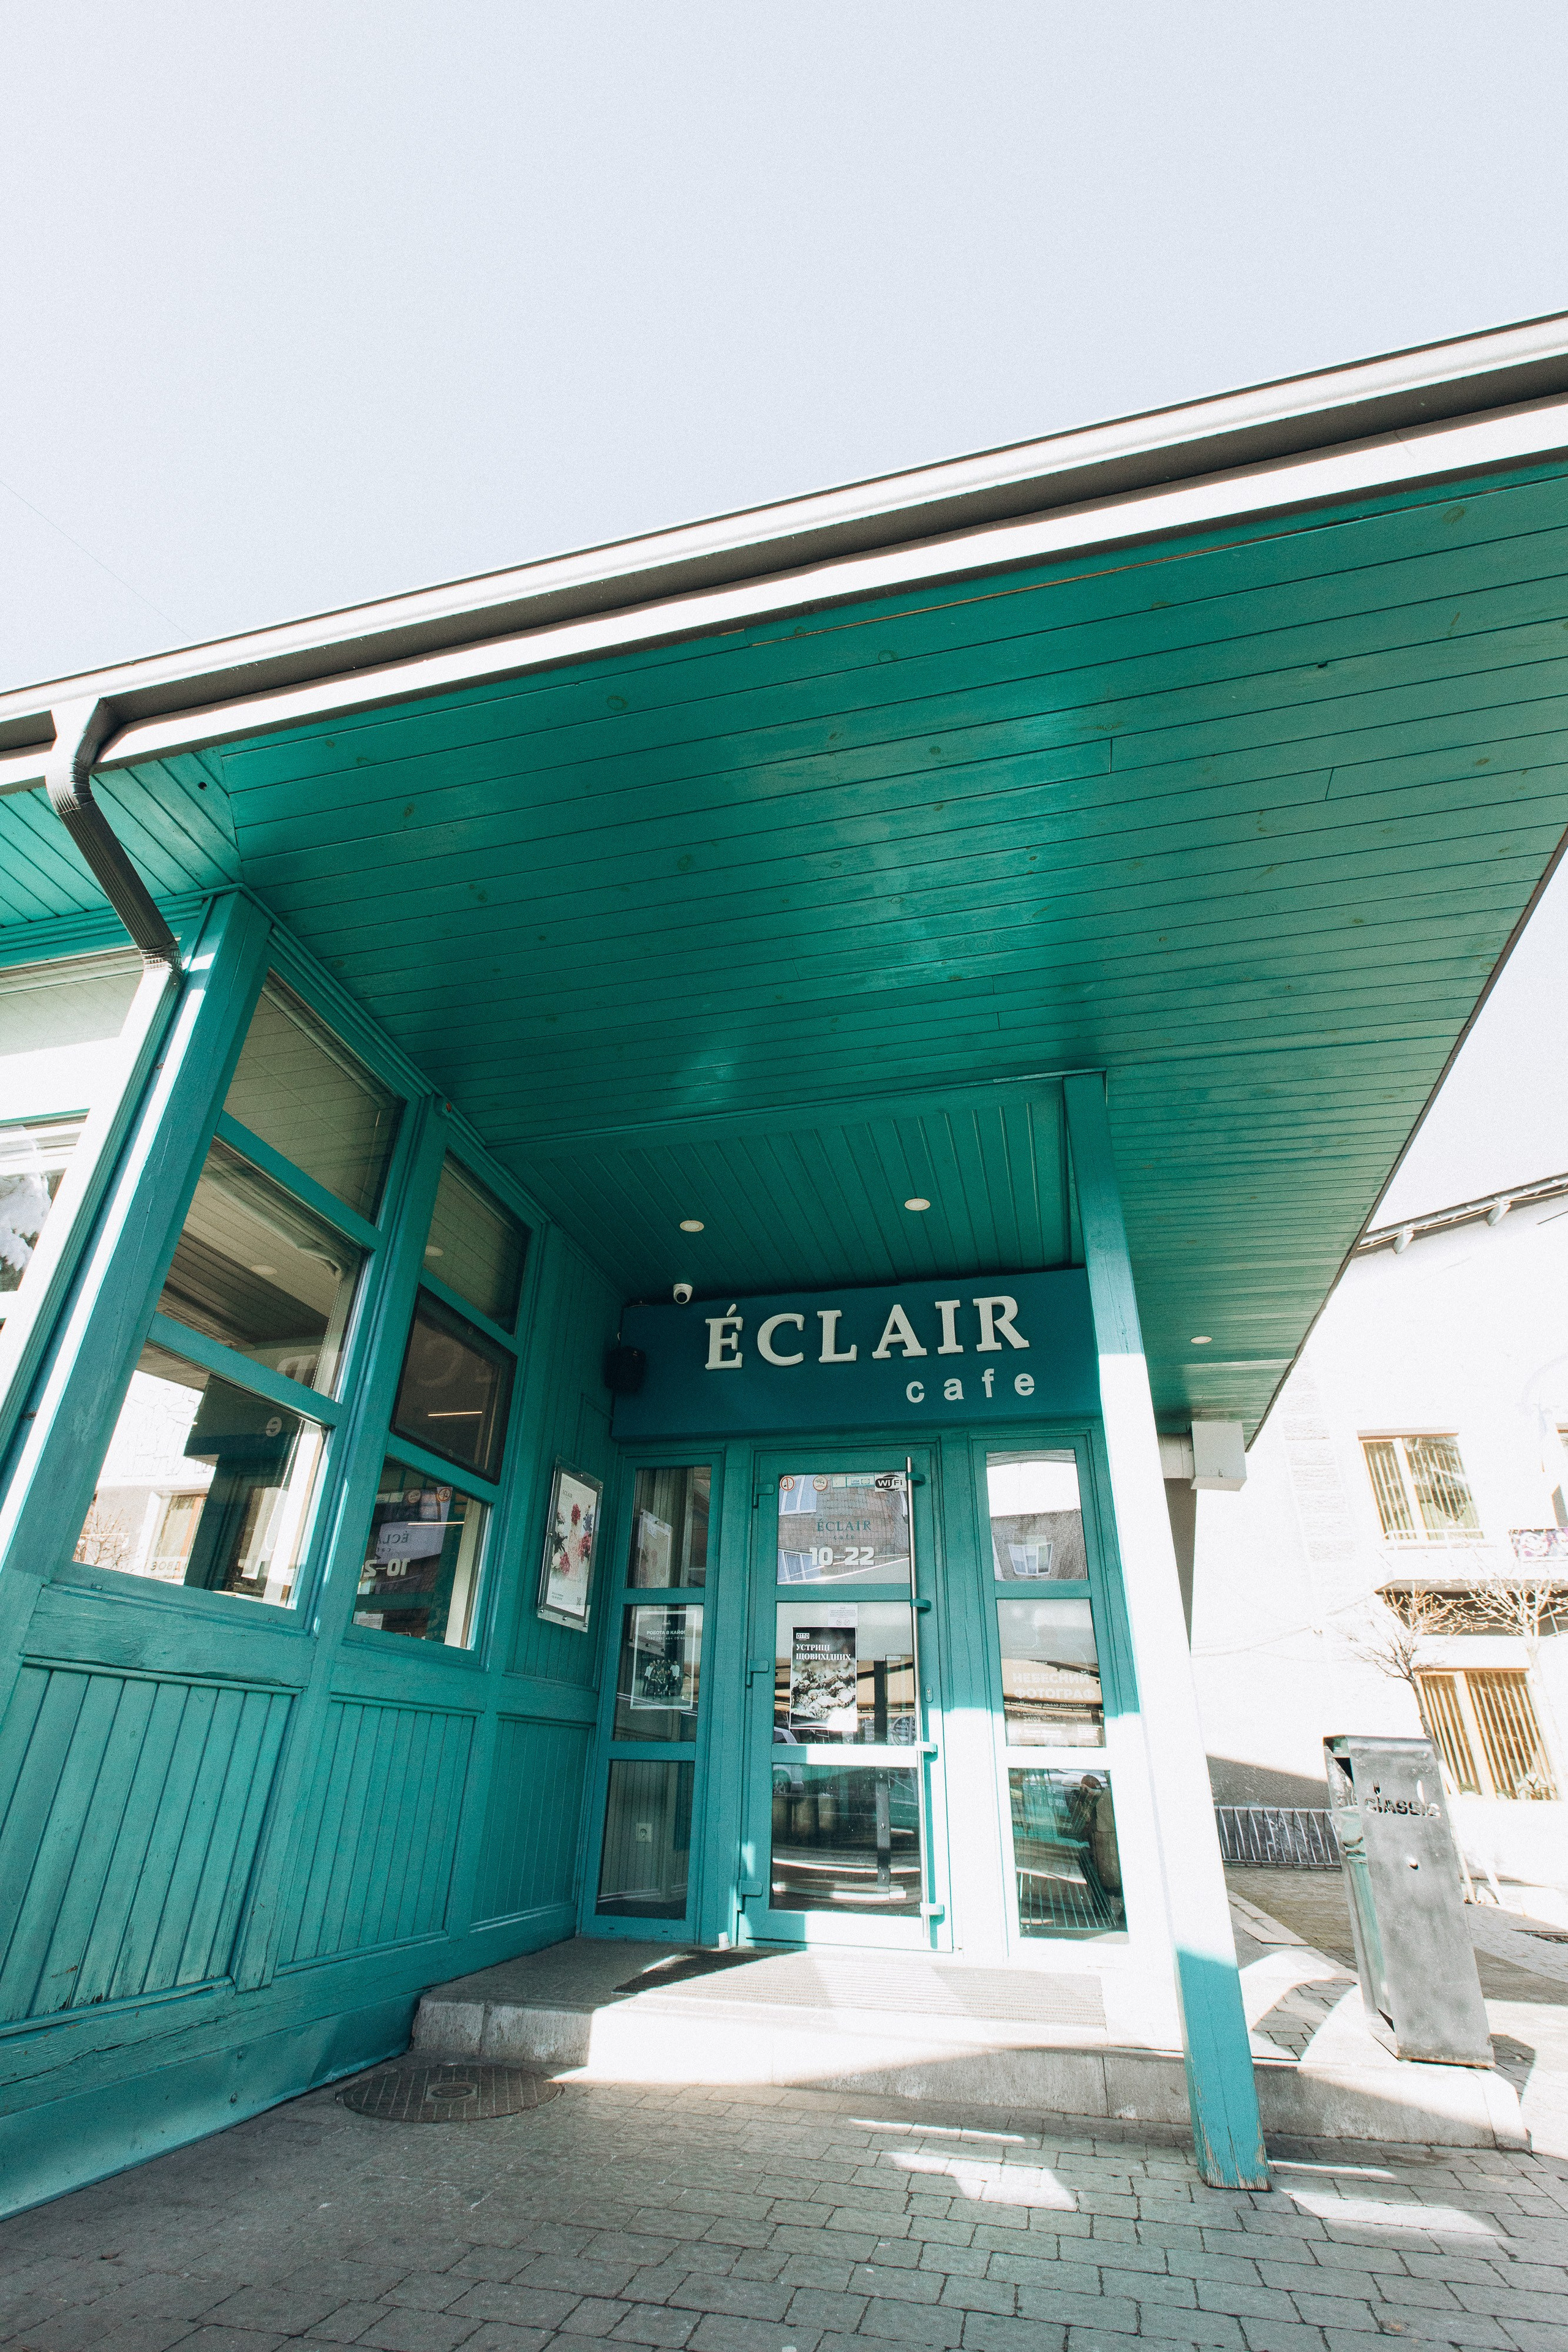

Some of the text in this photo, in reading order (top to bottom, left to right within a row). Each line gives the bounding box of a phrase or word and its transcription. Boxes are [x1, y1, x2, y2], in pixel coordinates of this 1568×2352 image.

[705, 1295, 1030, 1370] ÉCLAIR
[906, 1368, 1035, 1403] cafe
[817, 1518, 871, 1532] ÉCLAIR
[809, 1547, 874, 1566] 10-22
[1012, 1670, 1090, 1684] НЕБЕСНИЙ
[1014, 1687, 1096, 1699] ФОТОГРАФ
